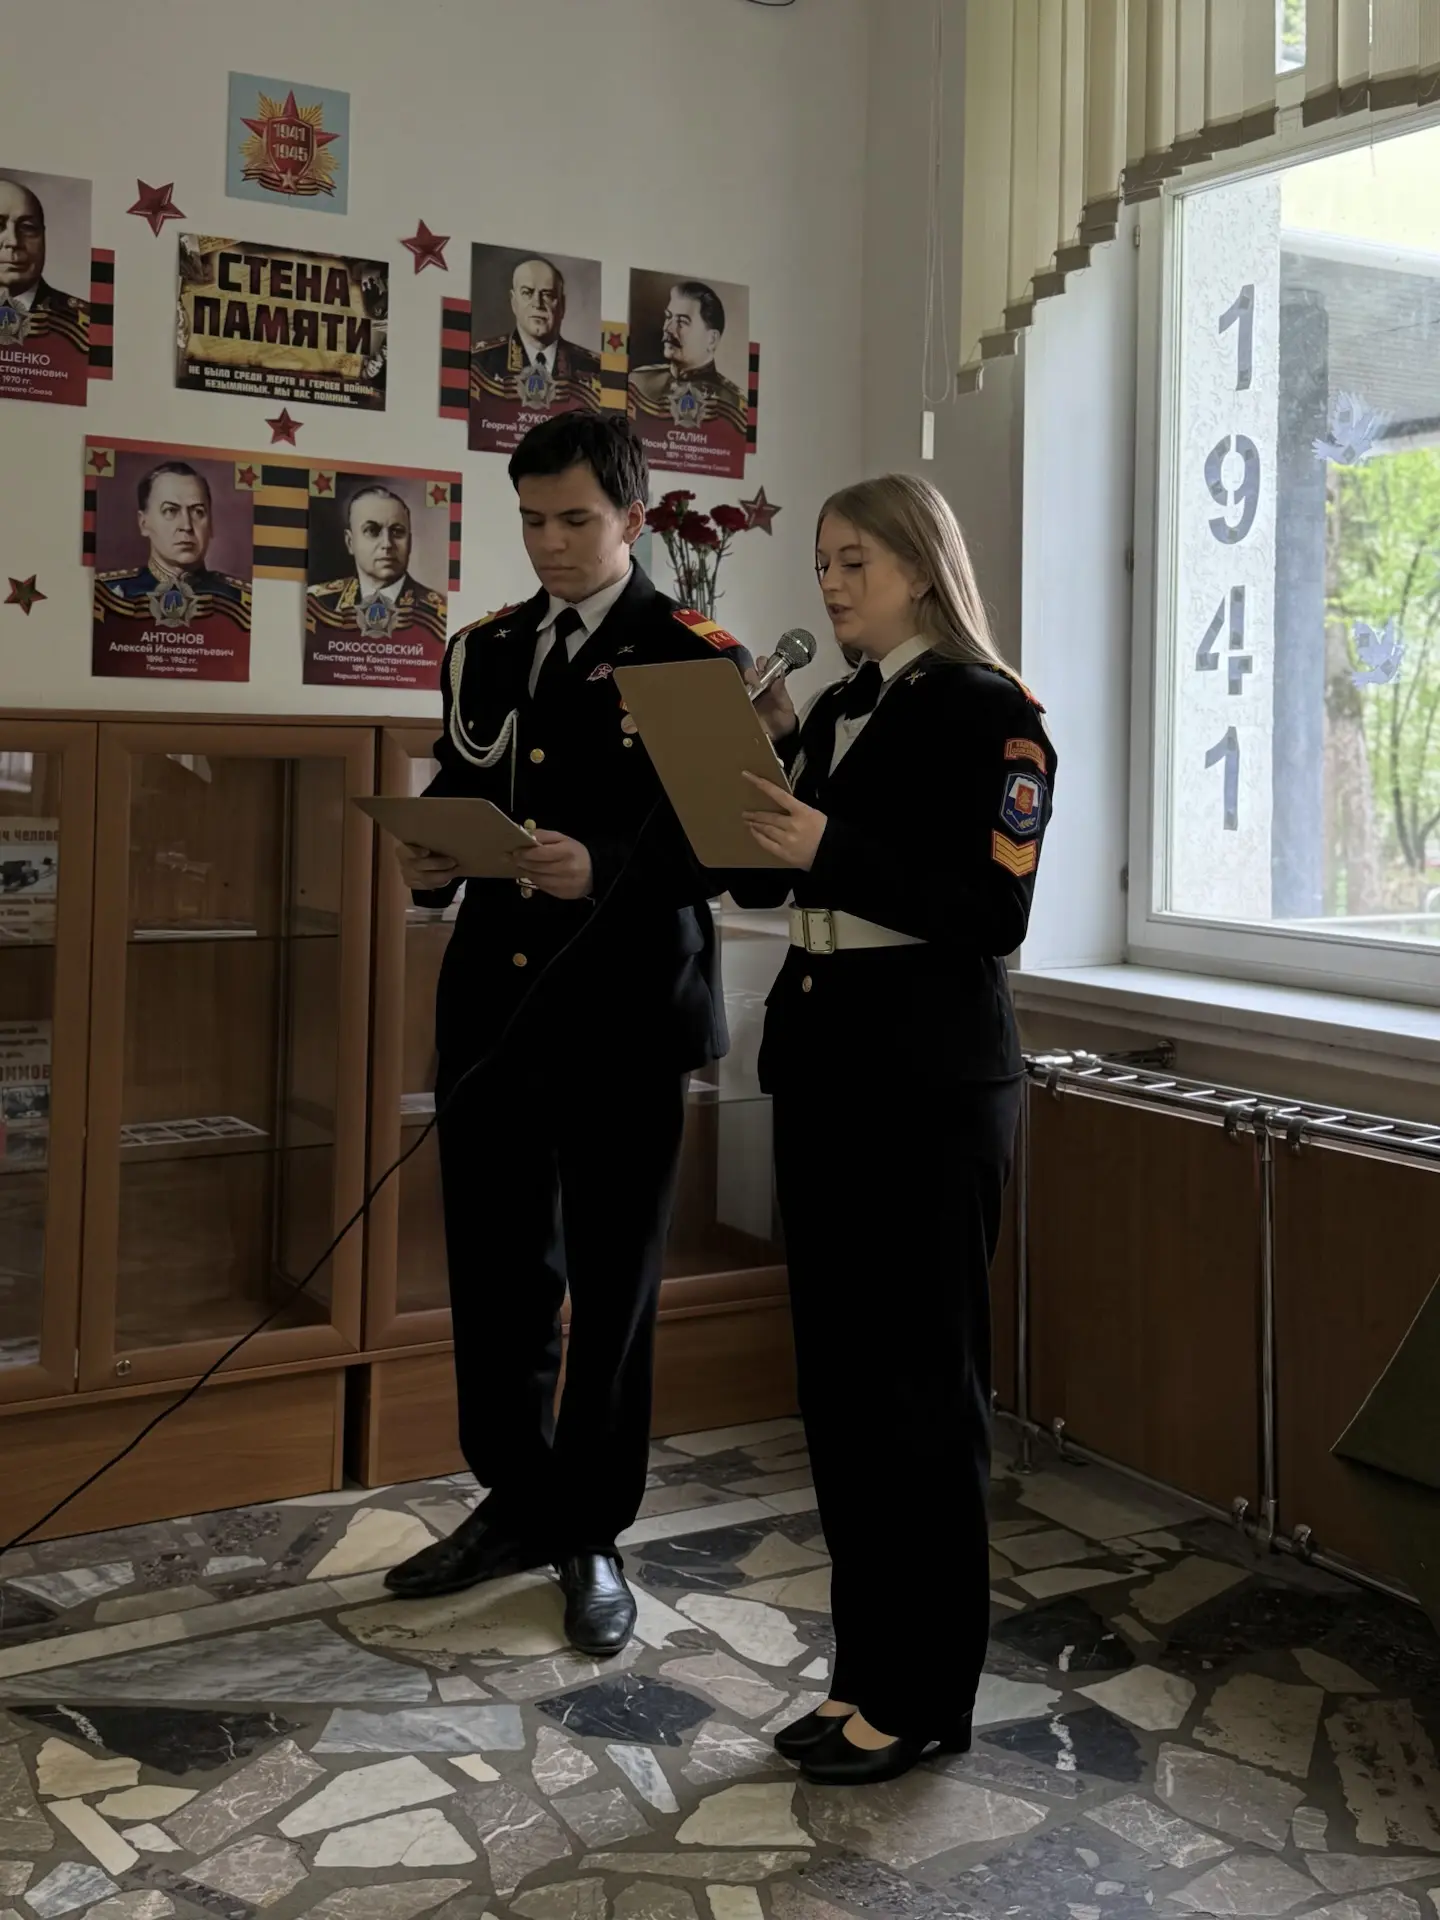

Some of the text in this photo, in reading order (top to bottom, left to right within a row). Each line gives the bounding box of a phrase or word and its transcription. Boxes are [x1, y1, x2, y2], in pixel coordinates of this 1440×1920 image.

[273, 123, 306, 142] 1941
[272, 144, 308, 162] 1945
[218, 252, 351, 307] СТЕНА
[193, 295, 371, 356] ПАМЯТИ
[0, 350, 51, 366] ШЕНКО
[2, 375, 21, 385] 1970
[188, 365, 200, 375] НЕ
[204, 366, 230, 378] БЫЛО
[234, 370, 262, 382] СРЕДИ
[266, 374, 295, 386] ЖЕРТВ
[299, 378, 306, 387] И
[309, 379, 340, 392] ГЕРОЕВ
[274, 386, 290, 397] МЫ
[293, 389, 311, 399] ВАС
[481, 418, 517, 432] Георгий
[641, 437, 668, 451] Иосиф
[667, 430, 708, 444] СТАЛИН
[140, 631, 204, 644] АНТОНОВ
[109, 641, 234, 656] Алексей Иннокентьевич
[328, 640, 424, 656] РОКОССОВСКИЙ
[146, 655, 164, 663] 1896
[170, 656, 188, 664] 1962
[313, 652, 437, 666] Константин Константинович
[351, 664, 368, 672] 1896
[373, 665, 390, 673] 1968
